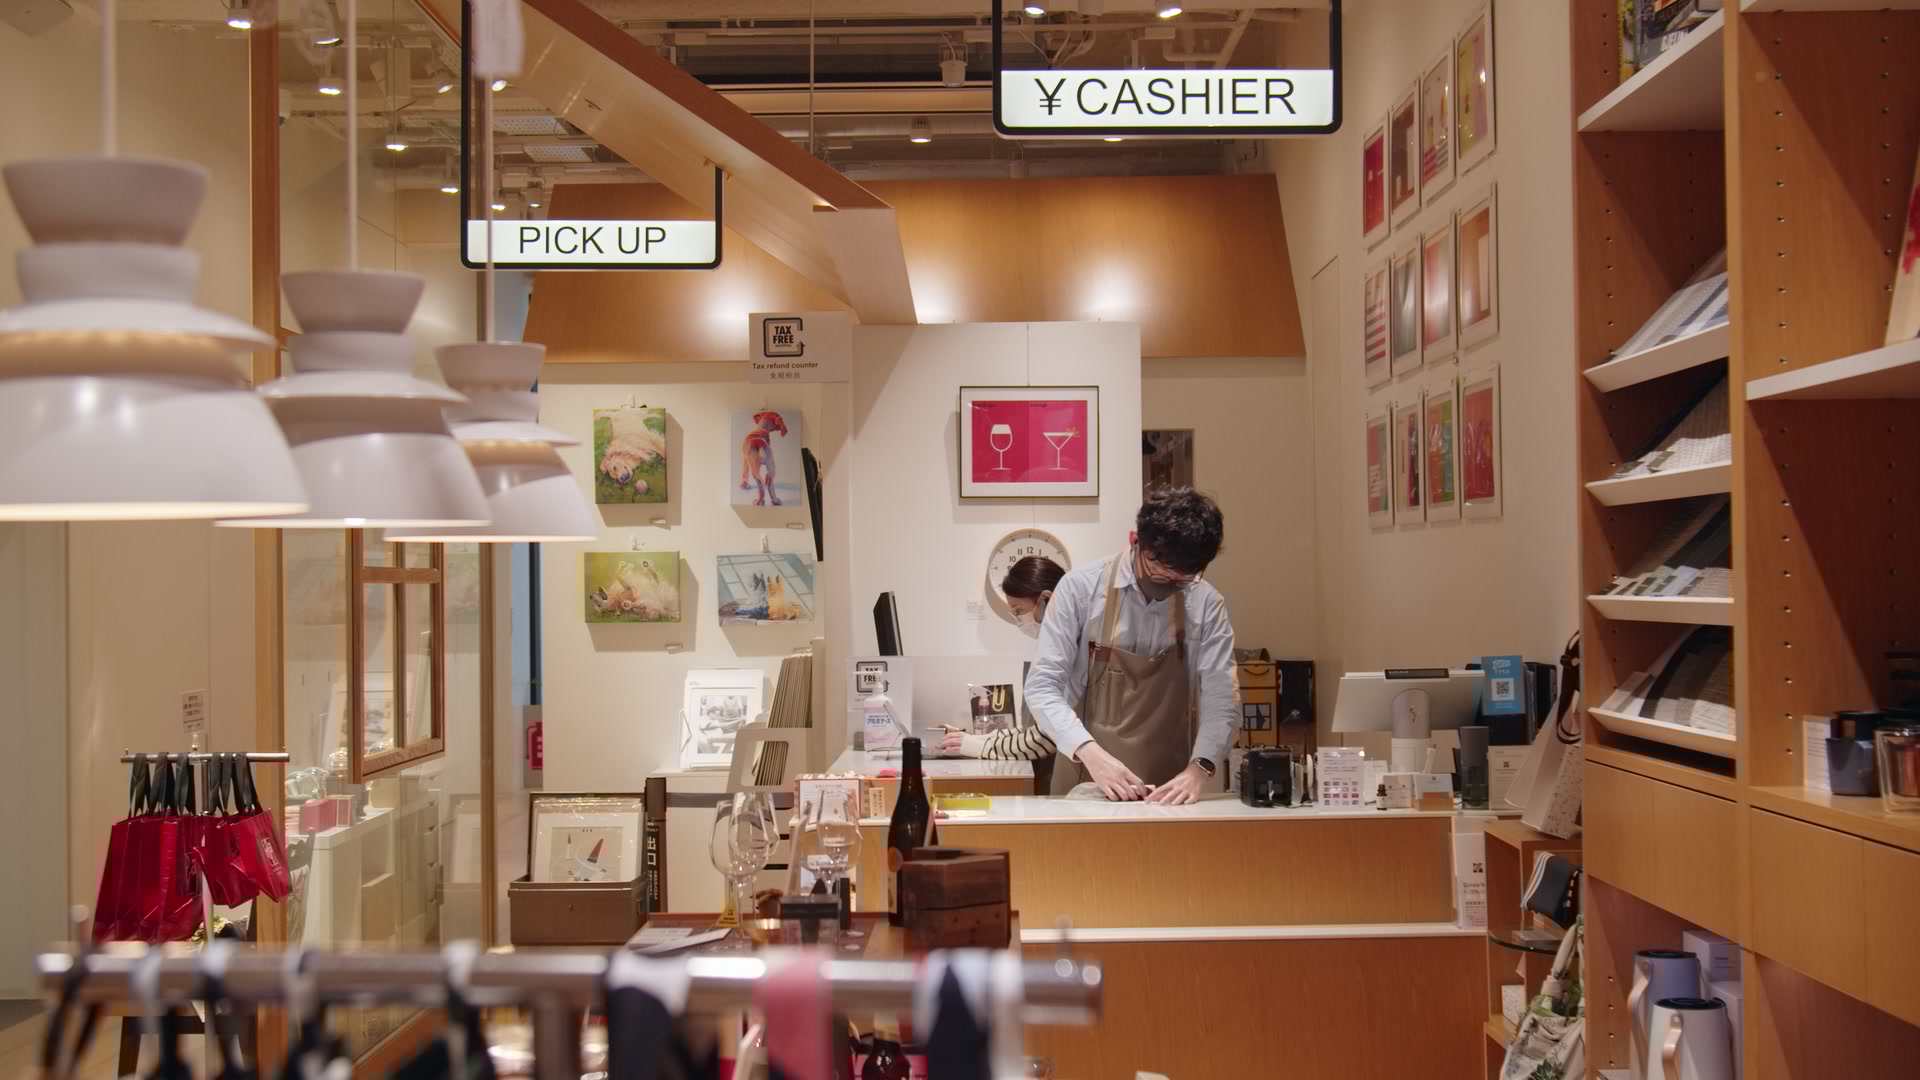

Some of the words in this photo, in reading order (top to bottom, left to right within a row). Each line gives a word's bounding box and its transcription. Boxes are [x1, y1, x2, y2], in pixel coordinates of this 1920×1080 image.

[1077, 78, 1296, 115] CASHIER
[520, 226, 604, 254] PICK
[619, 227, 666, 254] UP
[773, 335, 794, 344] FREE
[774, 325, 792, 335] TAX
